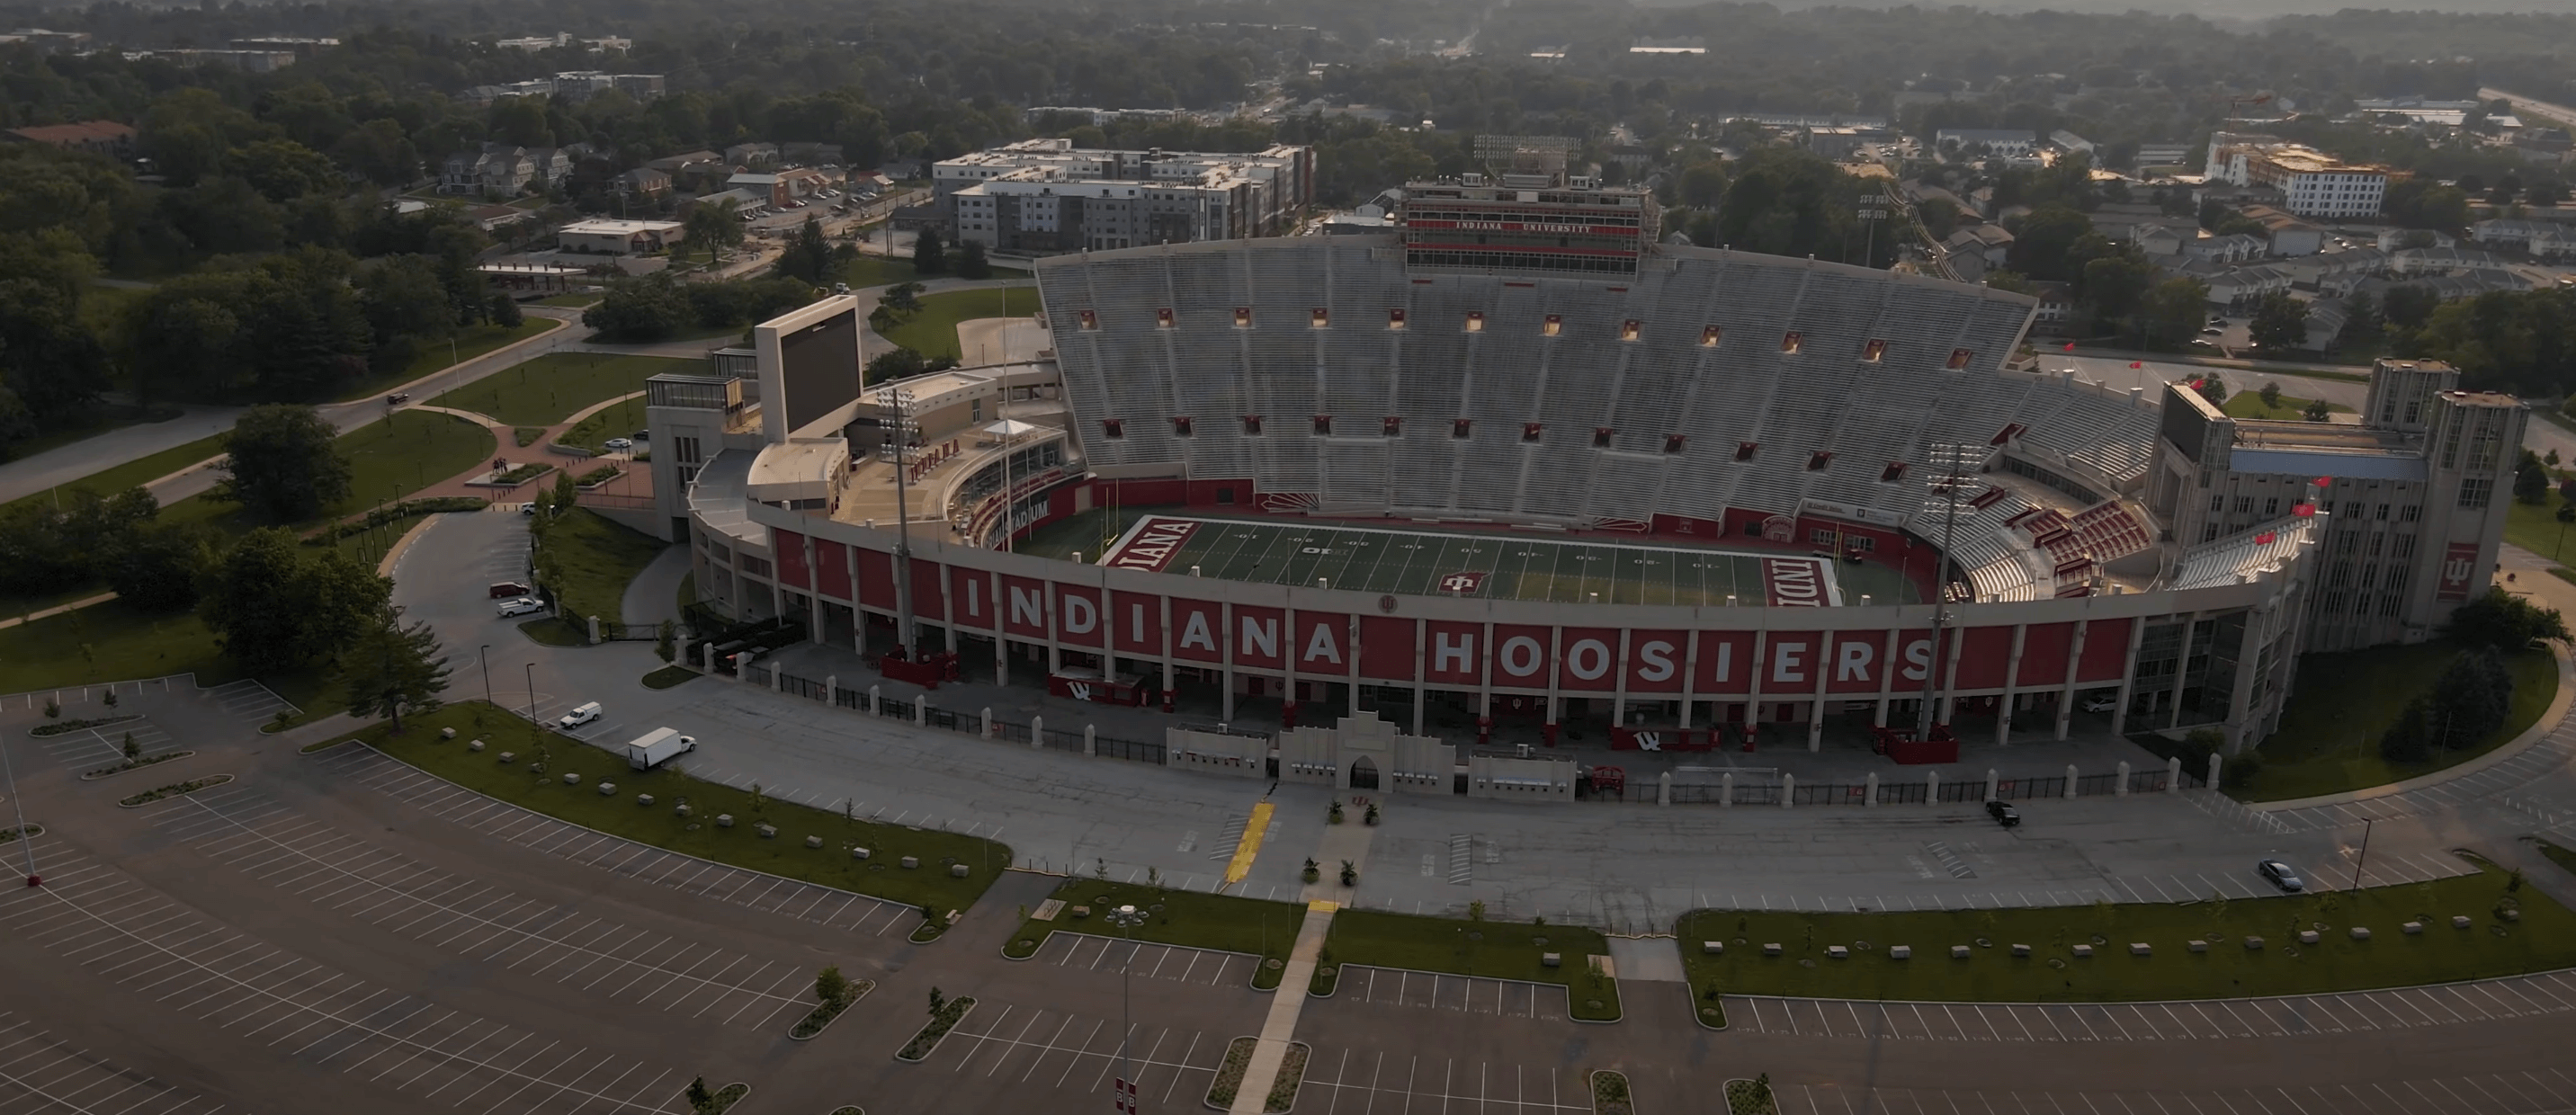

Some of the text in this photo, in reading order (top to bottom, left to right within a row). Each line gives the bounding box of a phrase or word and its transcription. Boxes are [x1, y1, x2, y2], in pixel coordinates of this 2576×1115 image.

[1456, 221, 1591, 233] INDIANA UNIVERSITY
[1770, 559, 1820, 608] INDI
[968, 579, 1931, 682] INDIANA HOOSIERS
